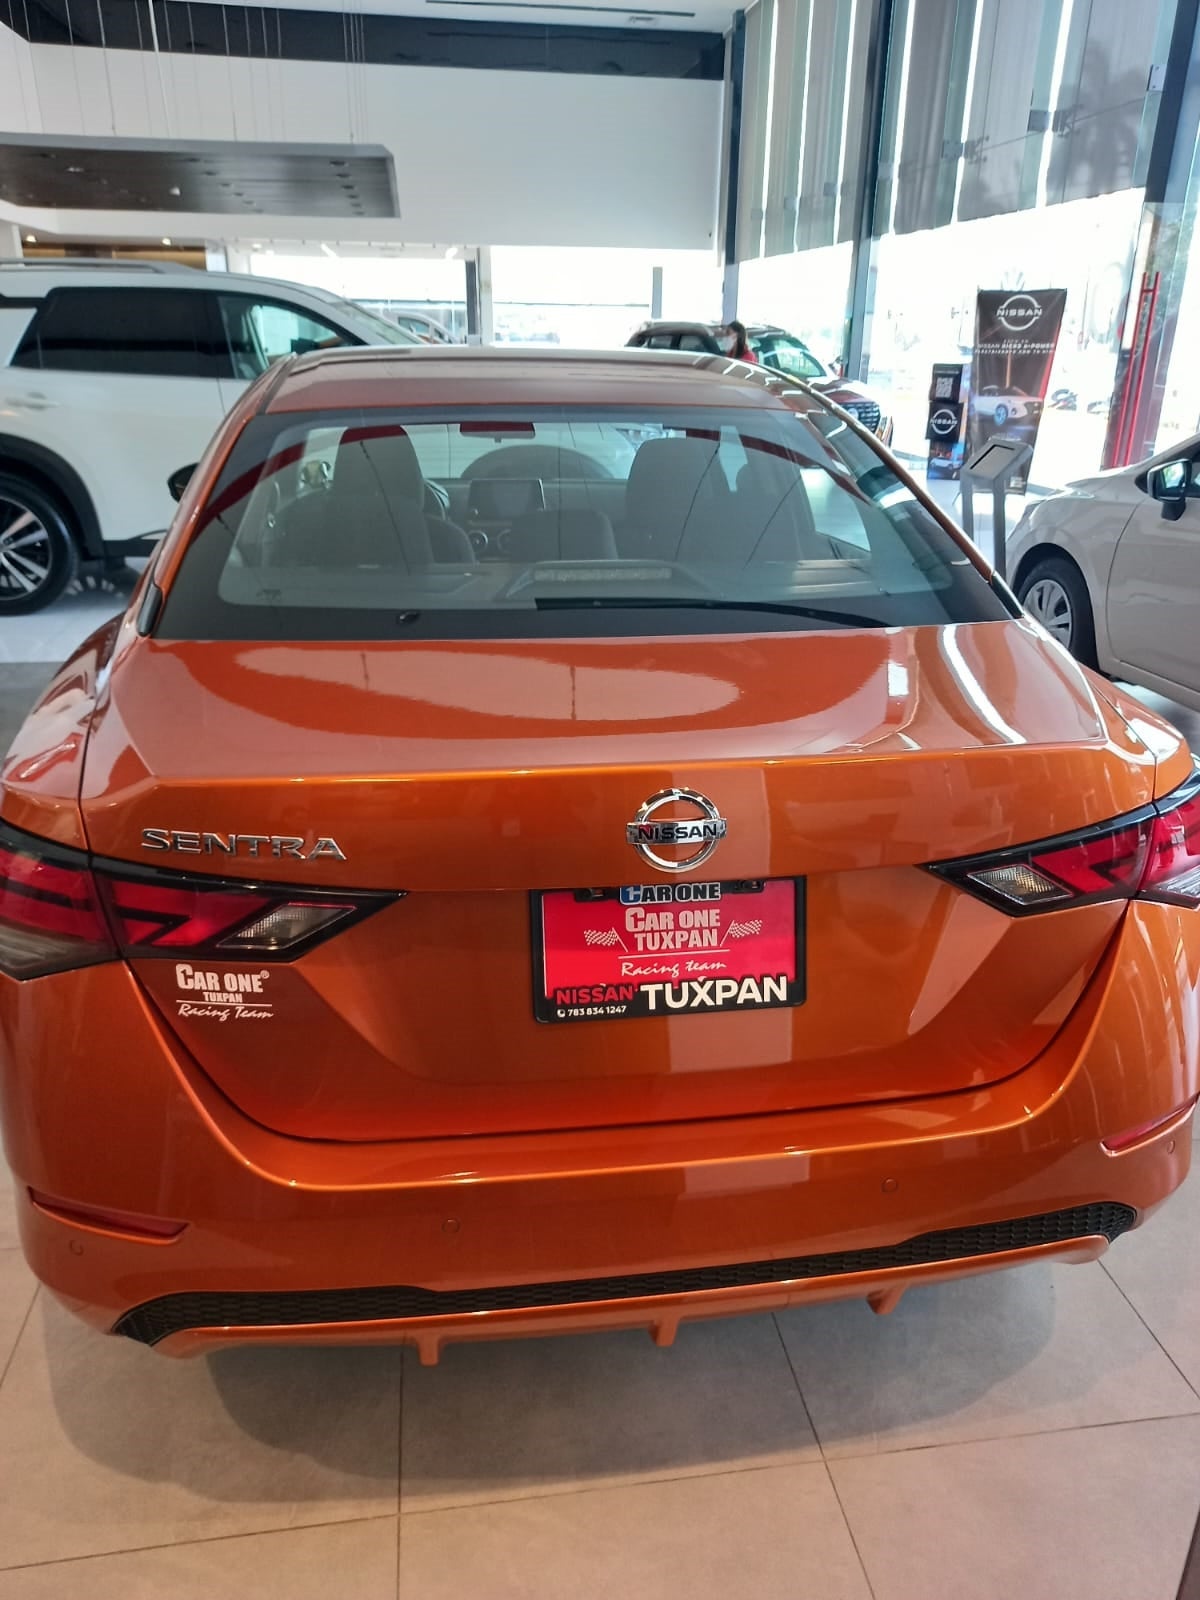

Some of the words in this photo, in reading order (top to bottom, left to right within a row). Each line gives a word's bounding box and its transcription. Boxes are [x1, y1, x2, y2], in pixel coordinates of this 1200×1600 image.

[996, 308, 1043, 316] NISSAN
[637, 823, 717, 840] NISSAN
[141, 828, 347, 860] SENTRA
[619, 884, 673, 905] CAR
[675, 882, 721, 901] ONE
[625, 907, 676, 932] CAR
[678, 908, 721, 927] ONE
[634, 928, 718, 952] TUXPAN
[175, 963, 220, 991] CAR
[621, 961, 680, 977] Racing
[685, 959, 727, 972] team
[202, 991, 243, 1003] TUXPAN
[556, 985, 633, 1005] NISSAN
[640, 975, 788, 1010] TUXPAN
[178, 1004, 231, 1022] Racing
[567, 1008, 586, 1017] 783
[586, 1006, 605, 1016] 834
[605, 1005, 627, 1014] 1247
